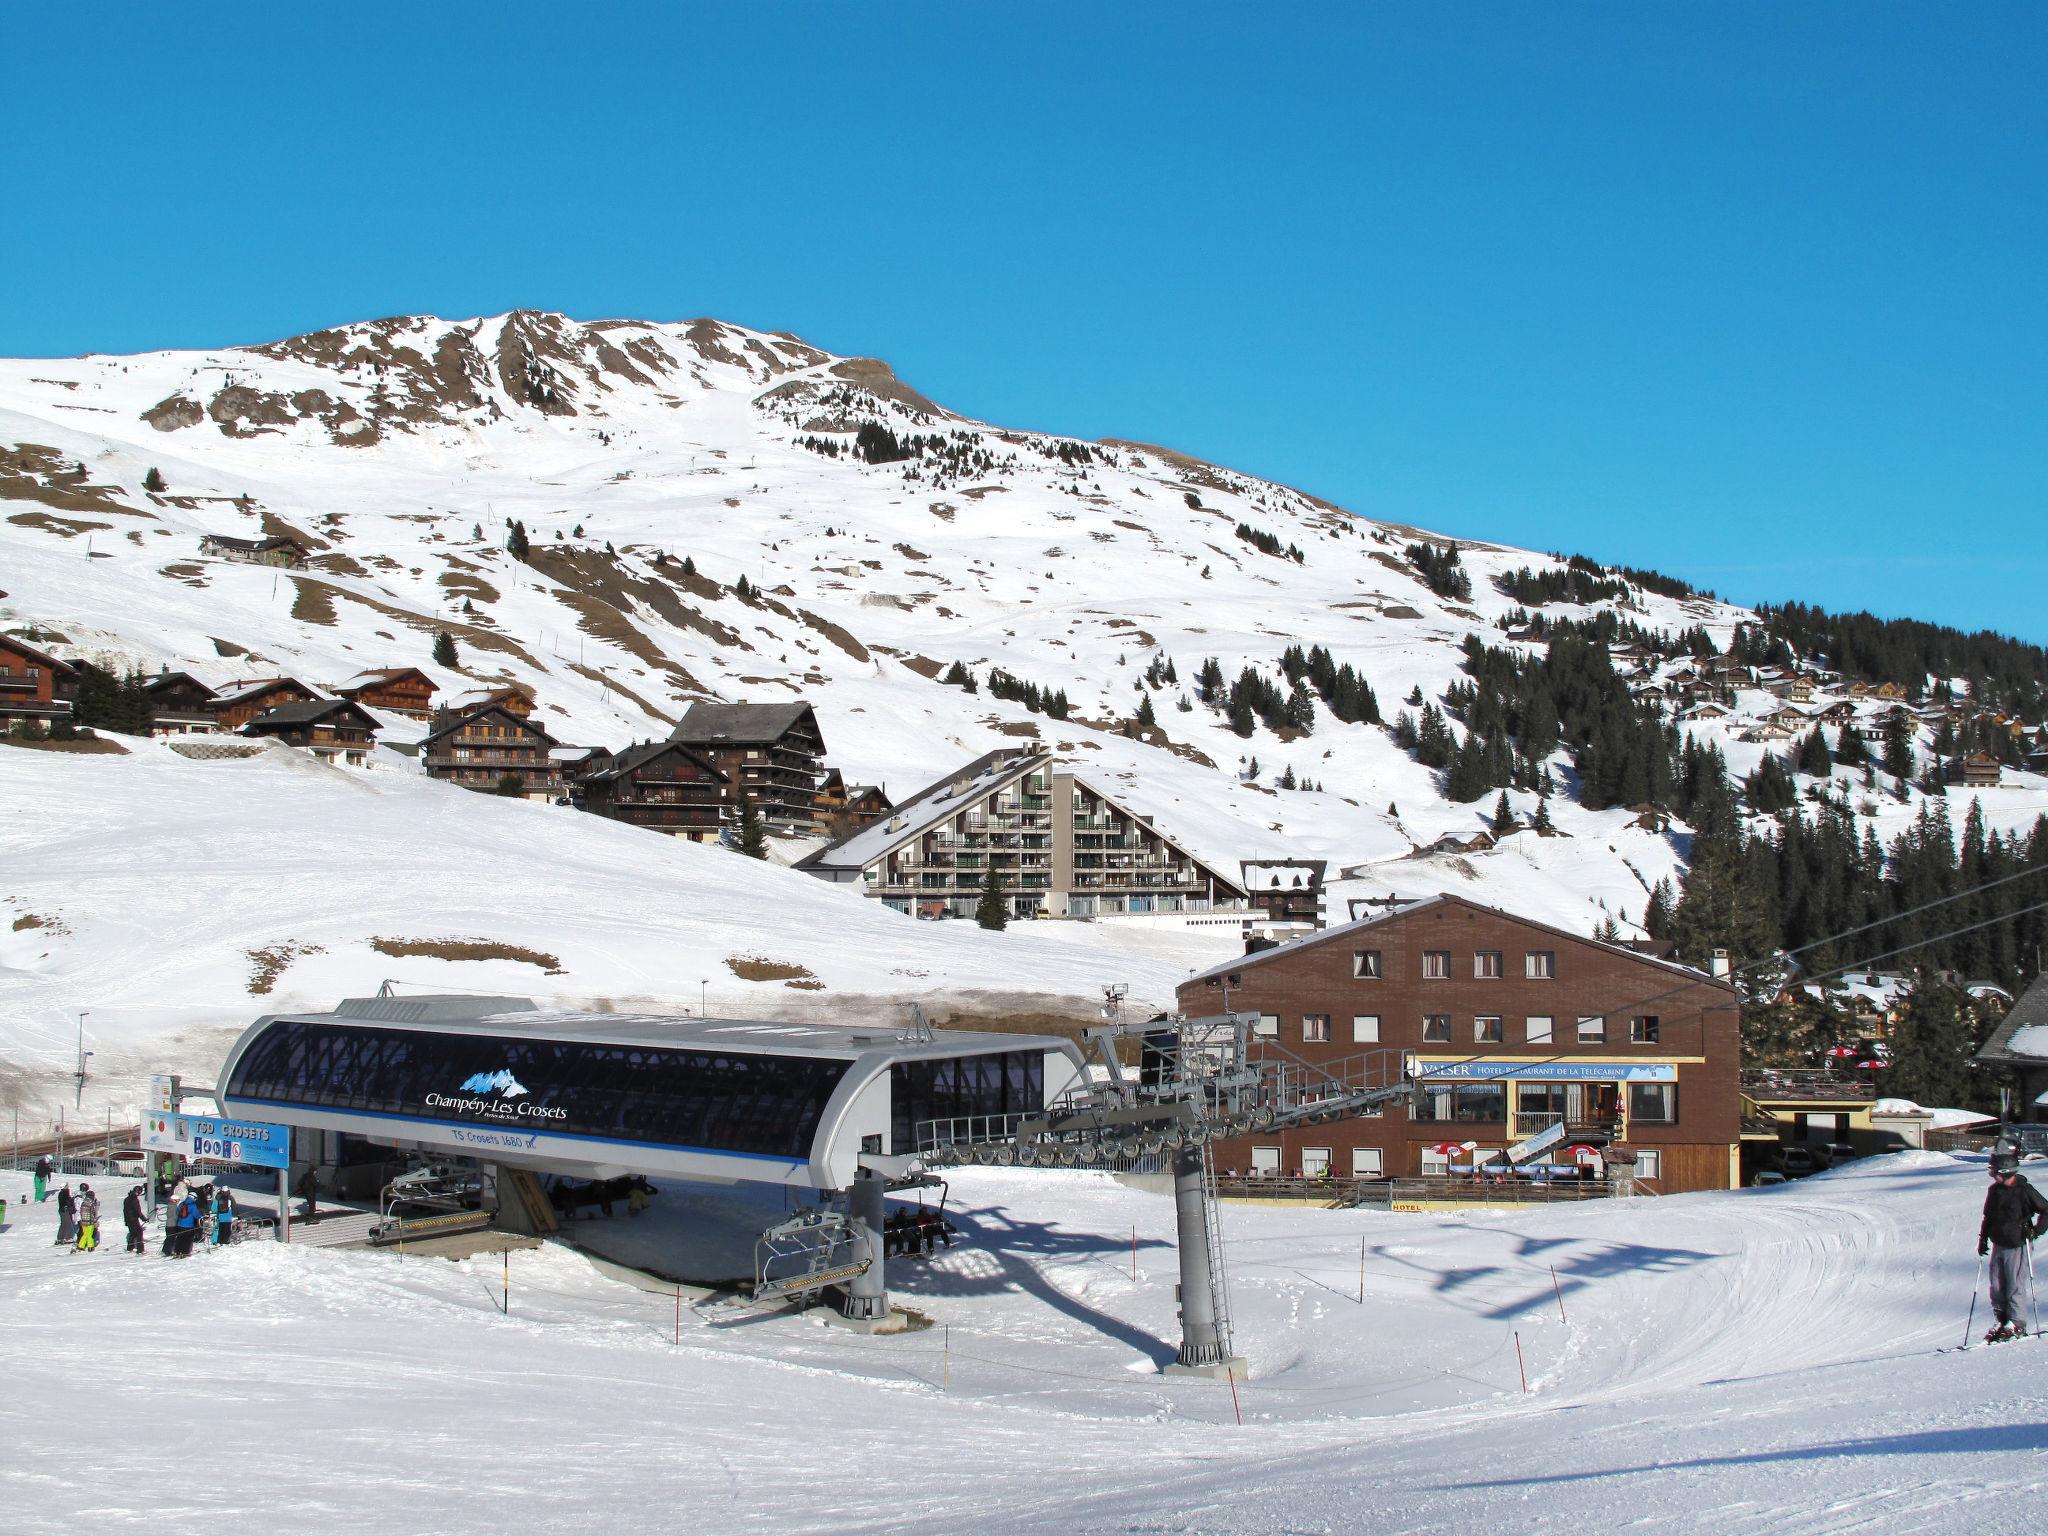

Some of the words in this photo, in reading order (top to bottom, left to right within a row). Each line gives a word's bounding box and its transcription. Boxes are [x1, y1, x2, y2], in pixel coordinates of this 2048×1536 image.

[1424, 1064, 1470, 1076] VALSER
[425, 1093, 514, 1114] Champéry-Les
[517, 1101, 568, 1119] Crosets
[196, 1121, 214, 1134] TSD
[223, 1125, 269, 1141] CROSETS
[452, 1130, 464, 1141] TS
[467, 1131, 499, 1145] Crosets
[502, 1135, 523, 1148] 1680
